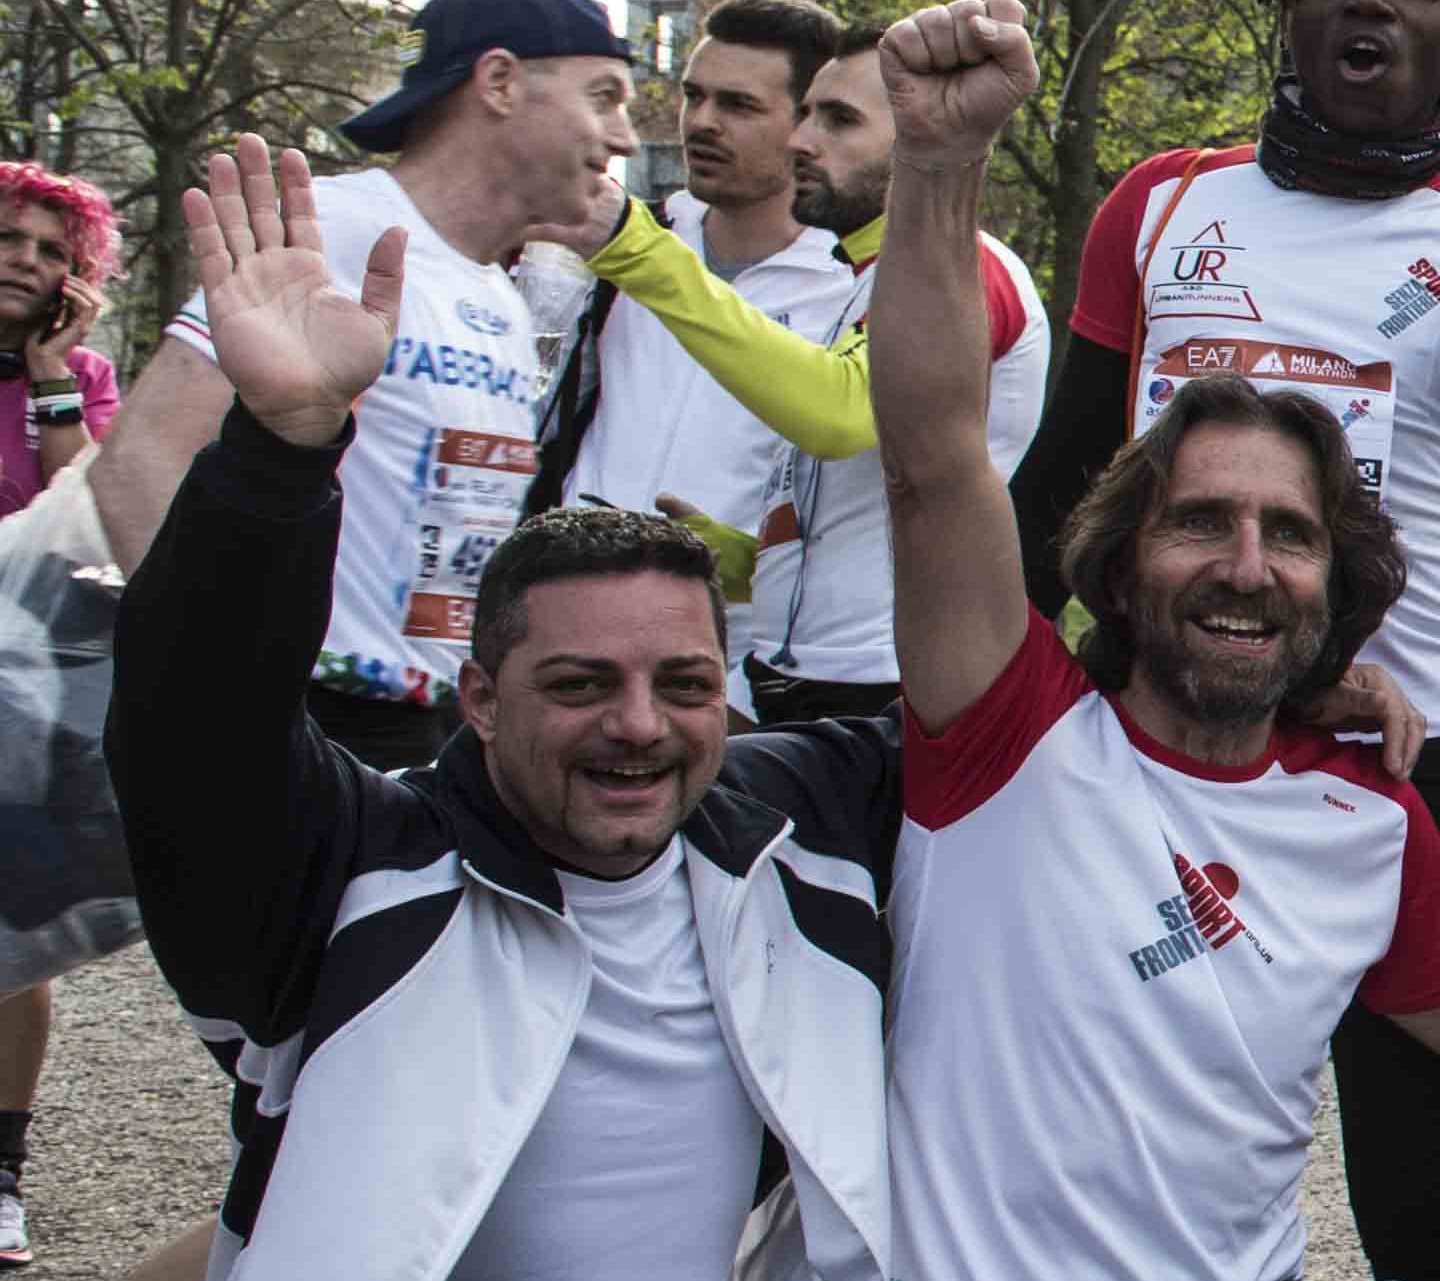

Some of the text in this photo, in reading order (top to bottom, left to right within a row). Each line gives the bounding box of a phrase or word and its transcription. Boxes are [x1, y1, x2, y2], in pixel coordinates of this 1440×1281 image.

[1174, 250, 1226, 281] UR
[1384, 279, 1426, 310] SENZA
[1187, 346, 1236, 367] EA7
